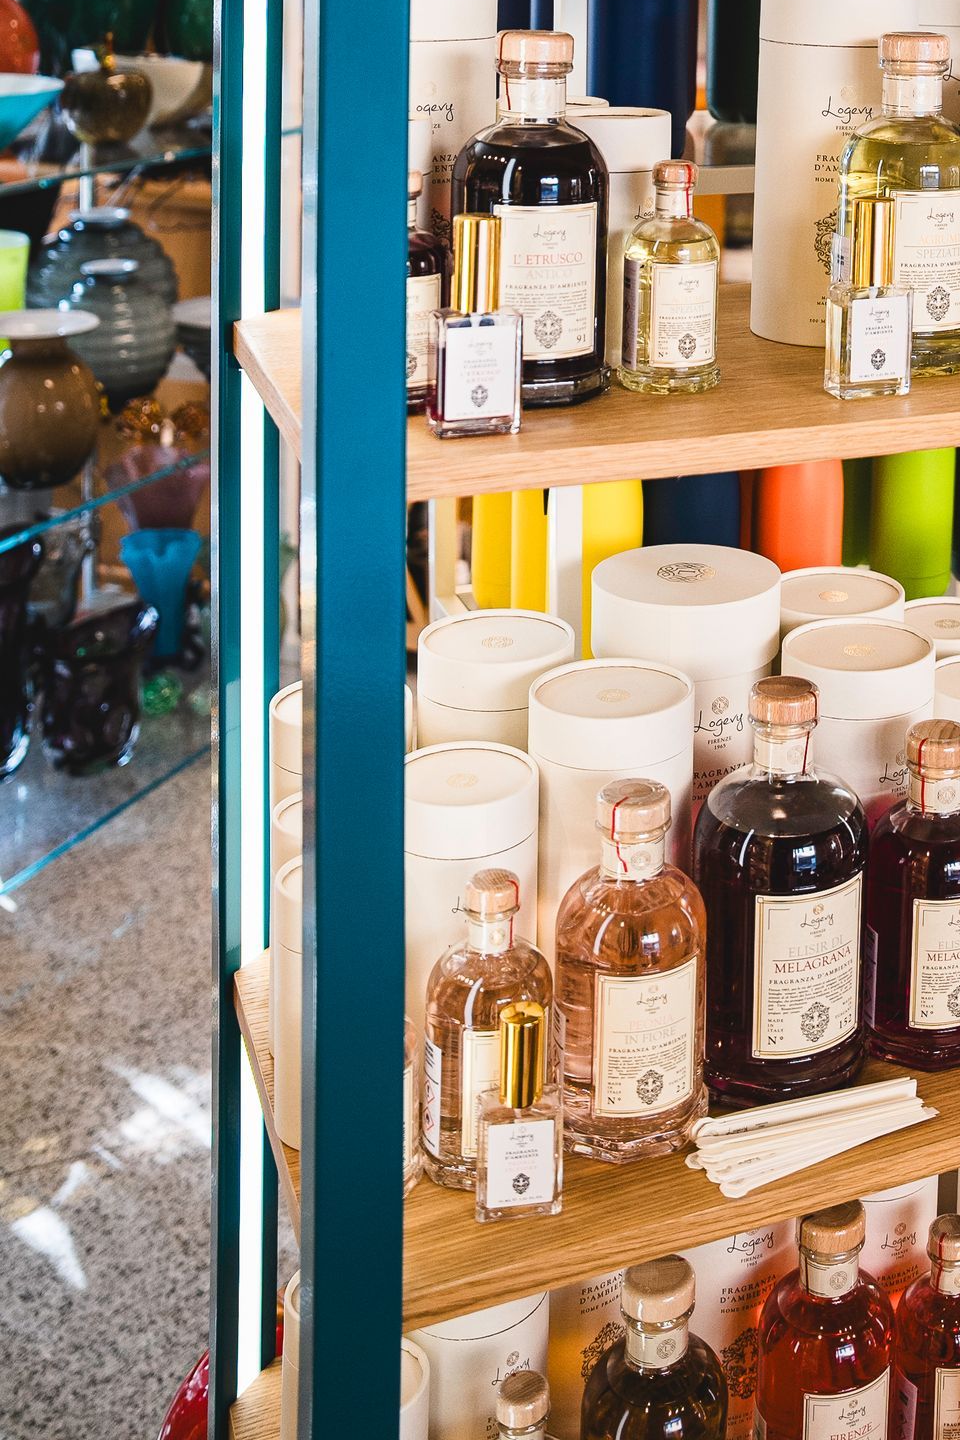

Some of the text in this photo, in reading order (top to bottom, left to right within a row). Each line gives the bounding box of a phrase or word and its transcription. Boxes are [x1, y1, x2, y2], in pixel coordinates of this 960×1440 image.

[416, 101, 454, 121] ogevy
[821, 95, 873, 124] Logevy
[927, 208, 954, 223] Logevy
[513, 252, 583, 264] L' ETRUSCO
[916, 248, 960, 259] SPEZIATI
[526, 268, 572, 279] ANTICO
[576, 334, 586, 343] 91
[694, 710, 745, 736] Logevy
[707, 736, 732, 745] FIRENZE
[879, 763, 909, 786] Loge
[800, 912, 834, 929] Logevy
[788, 935, 844, 958] ELISIR DI
[774, 945, 852, 974] MELAGRANA
[768, 959, 853, 985] FRAGRANZA D'AMBIENTE
[625, 1027, 677, 1044] IN FIORE
[652, 1033, 687, 1050] D'AMBIENTE
[727, 1231, 774, 1256] Logevy
[881, 1231, 917, 1253] Logevy
[741, 1253, 763, 1263] FIRENZE
[721, 1274, 777, 1295] FRAGRANZA
[580, 1305, 599, 1314] HOME
[839, 1405, 866, 1421] Logevy
